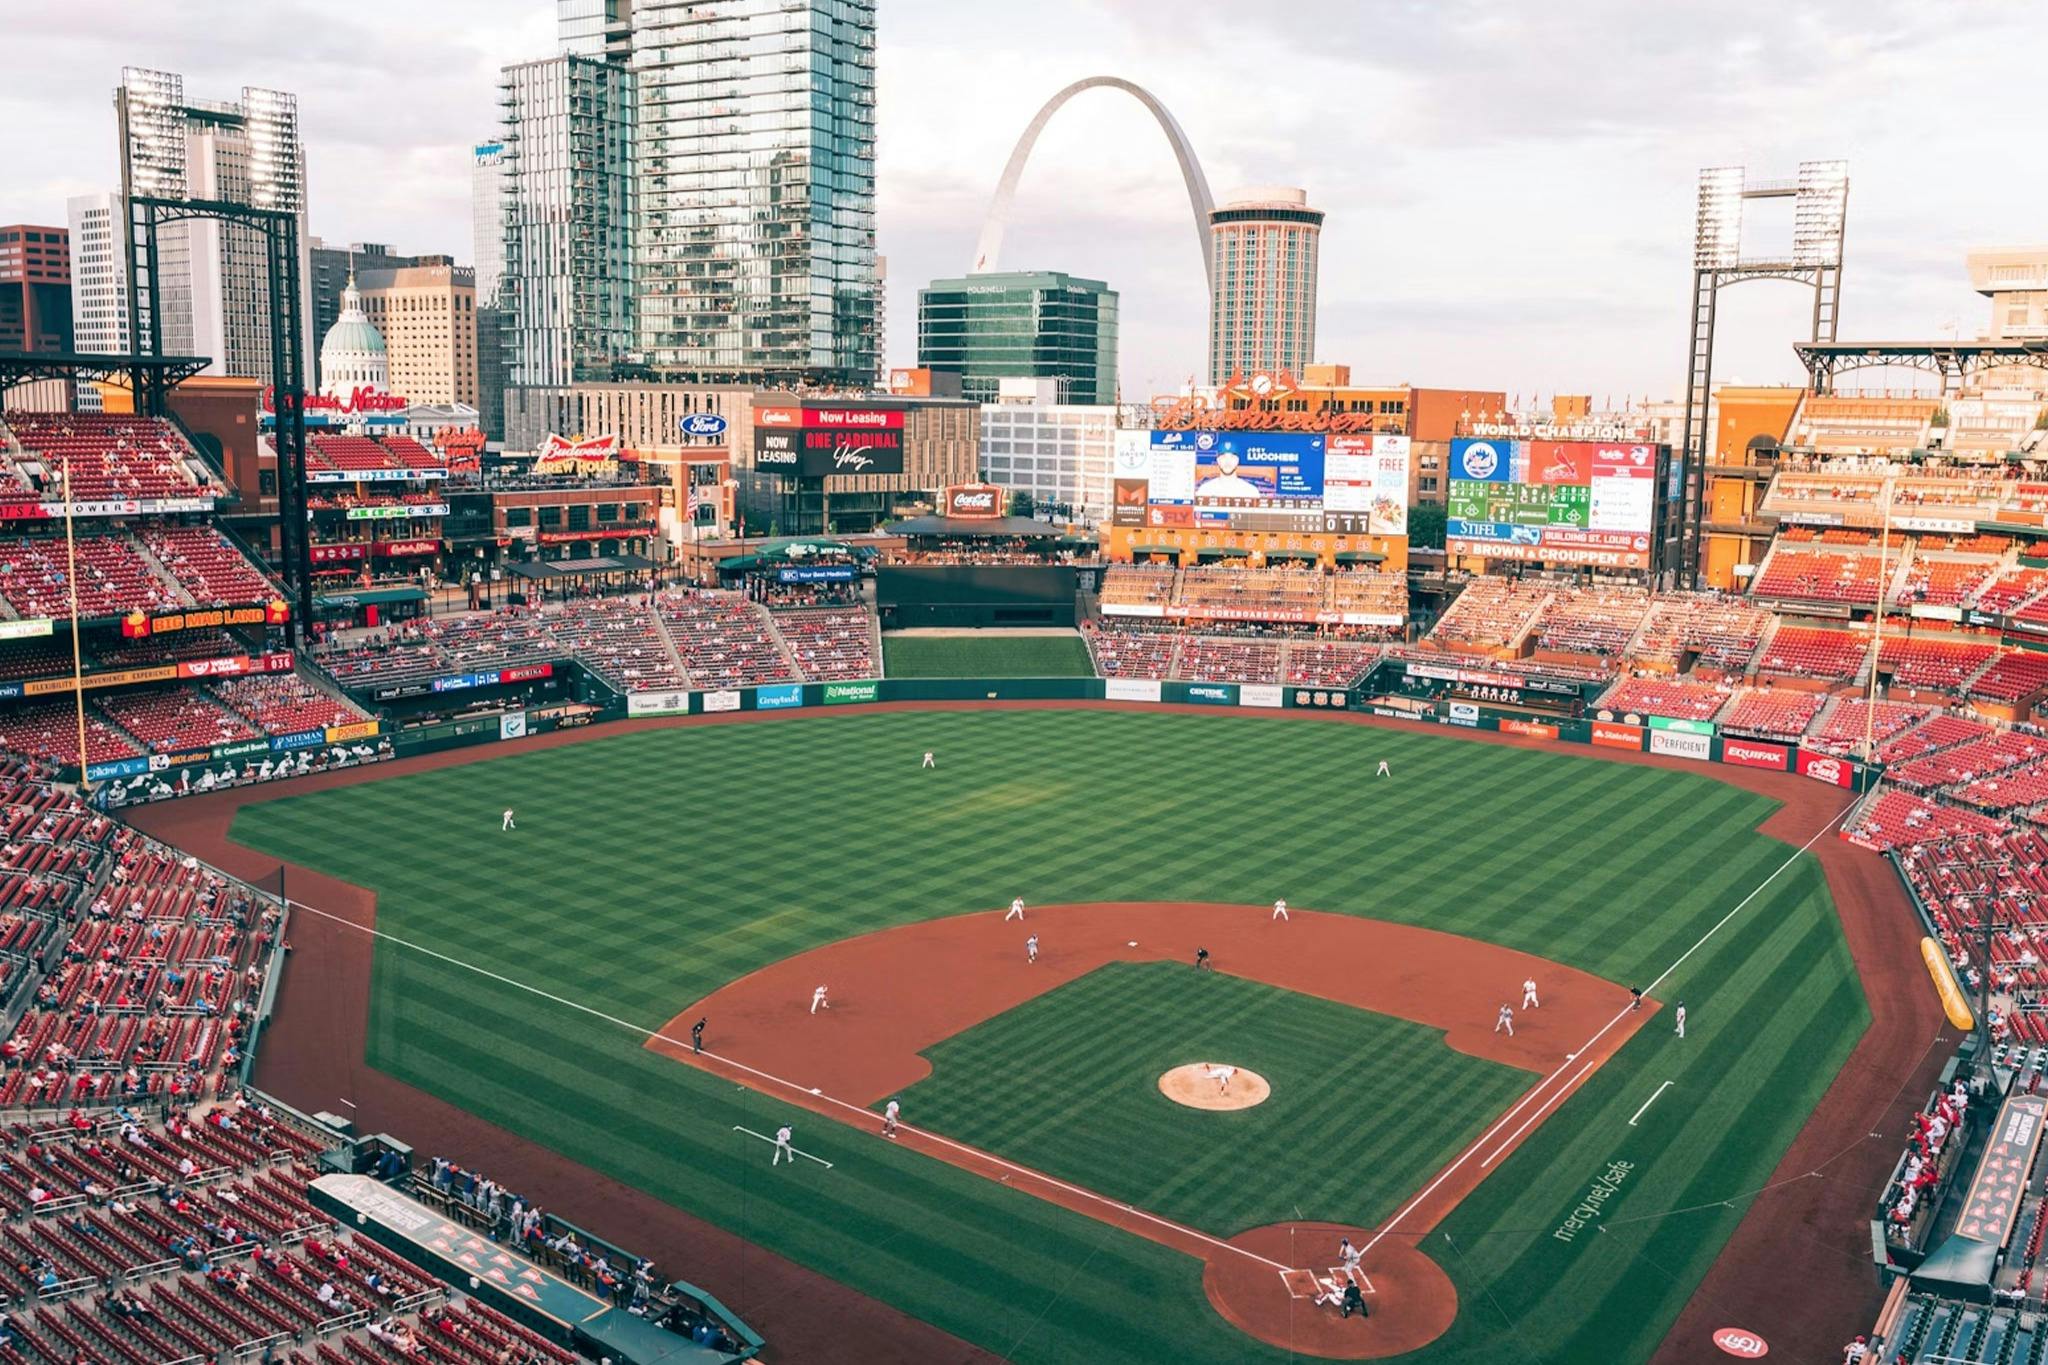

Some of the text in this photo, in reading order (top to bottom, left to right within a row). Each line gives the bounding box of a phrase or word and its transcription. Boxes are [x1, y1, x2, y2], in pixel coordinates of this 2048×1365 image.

[342, 386, 407, 414] Nation
[820, 411, 886, 426] Now Leasing
[1152, 395, 1373, 432] Budweiser
[689, 416, 720, 433] Ford
[1472, 423, 1635, 440] WORLD CHAMPIONS
[766, 436, 788, 448] NOW
[806, 431, 899, 449] ONE CARDINAL
[1334, 436, 1365, 448] Cardinals
[537, 442, 618, 460] Budweiser
[757, 450, 797, 464] LEASING
[833, 441, 874, 471] Way
[1247, 453, 1299, 462] LUCCHESI
[536, 460, 619, 475] BREW HOUSE
[1378, 458, 1405, 472] FREE
[954, 492, 993, 507] Coca-Cola
[1327, 519, 1336, 531] 0
[1344, 519, 1351, 531] 1
[1360, 520, 1366, 532] 1
[1460, 520, 1498, 536] STIFEL
[1544, 531, 1587, 542] BUILDING
[1604, 535, 1631, 545] LOUIS
[1472, 543, 1524, 558] BROWN
[1538, 548, 1619, 565] CROUPPEN
[152, 608, 265, 633] BIG MAC LAND
[1203, 608, 1269, 618] SCOREBOARD
[1273, 610, 1303, 620] PATIO
[32, 669, 171, 692] FLEXIBILITY CONVENIENCE EXPERIENCE
[838, 685, 875, 697] National
[285, 731, 323, 743] SITEMAN
[336, 724, 369, 736] DOBBS
[224, 741, 269, 756] Central Bank
[1652, 734, 1706, 753] PERFICIENT
[1728, 746, 1780, 763] EQUIFAX
[1553, 1160, 1635, 1242] mercy.net/safe
